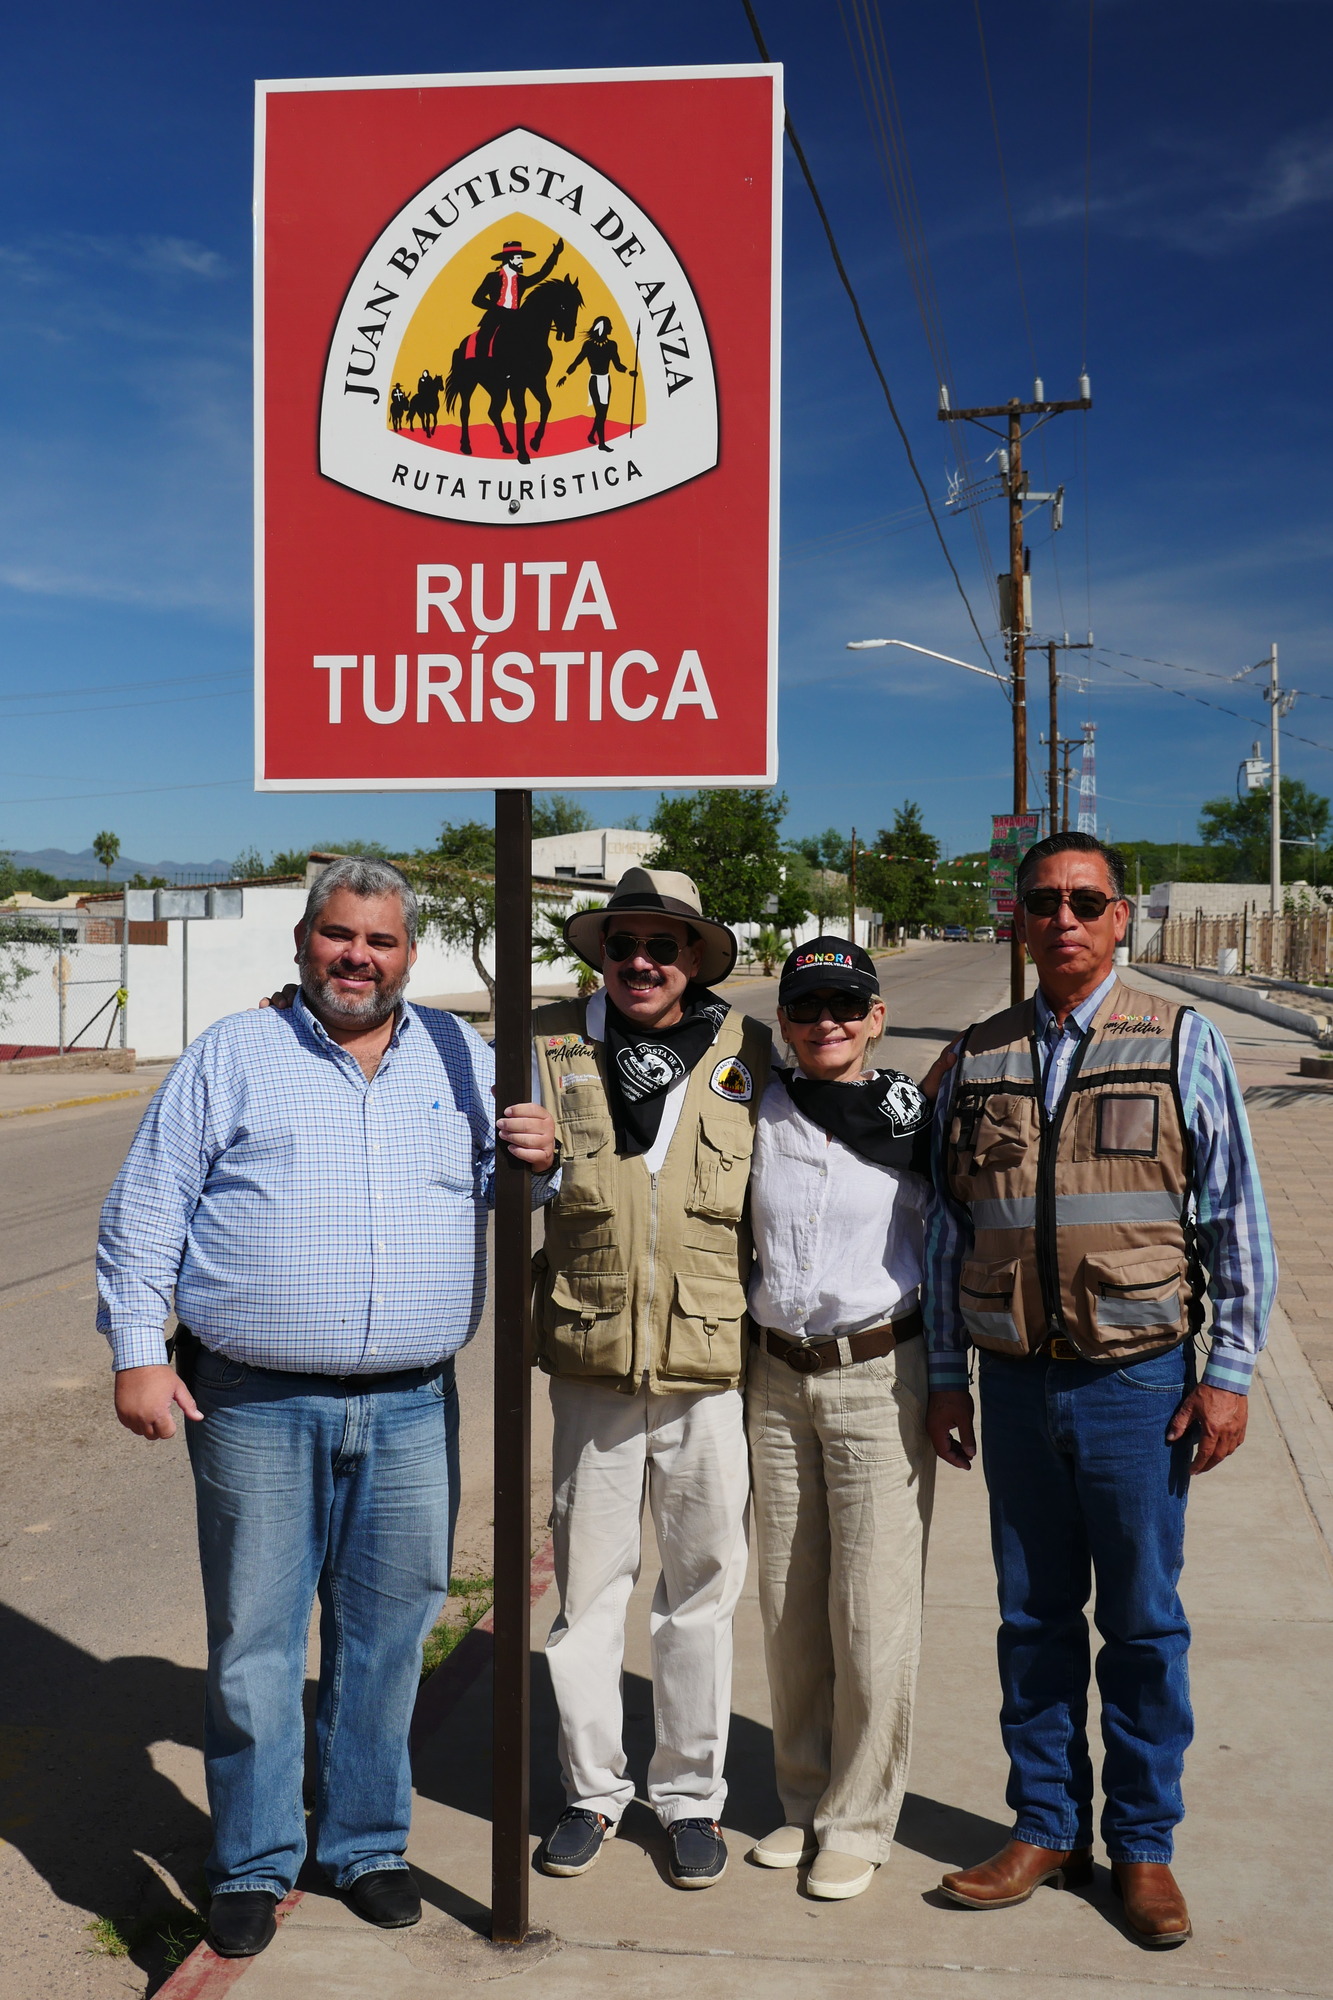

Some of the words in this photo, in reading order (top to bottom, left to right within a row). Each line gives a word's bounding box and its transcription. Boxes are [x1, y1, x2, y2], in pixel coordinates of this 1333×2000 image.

[344, 281, 400, 405] JUAN
[387, 165, 587, 279] BAUTISTA
[591, 206, 646, 268] DE
[635, 278, 694, 397] ANZA
[392, 463, 467, 498] RUTA
[478, 460, 643, 501] TURÍSTICA
[416, 560, 618, 633] RUTA
[313, 635, 718, 725] TURÍSTICA
[796, 952, 853, 967] SONORA
[1110, 1012, 1159, 1022] SONORA
[667, 1055, 677, 1067] DE
